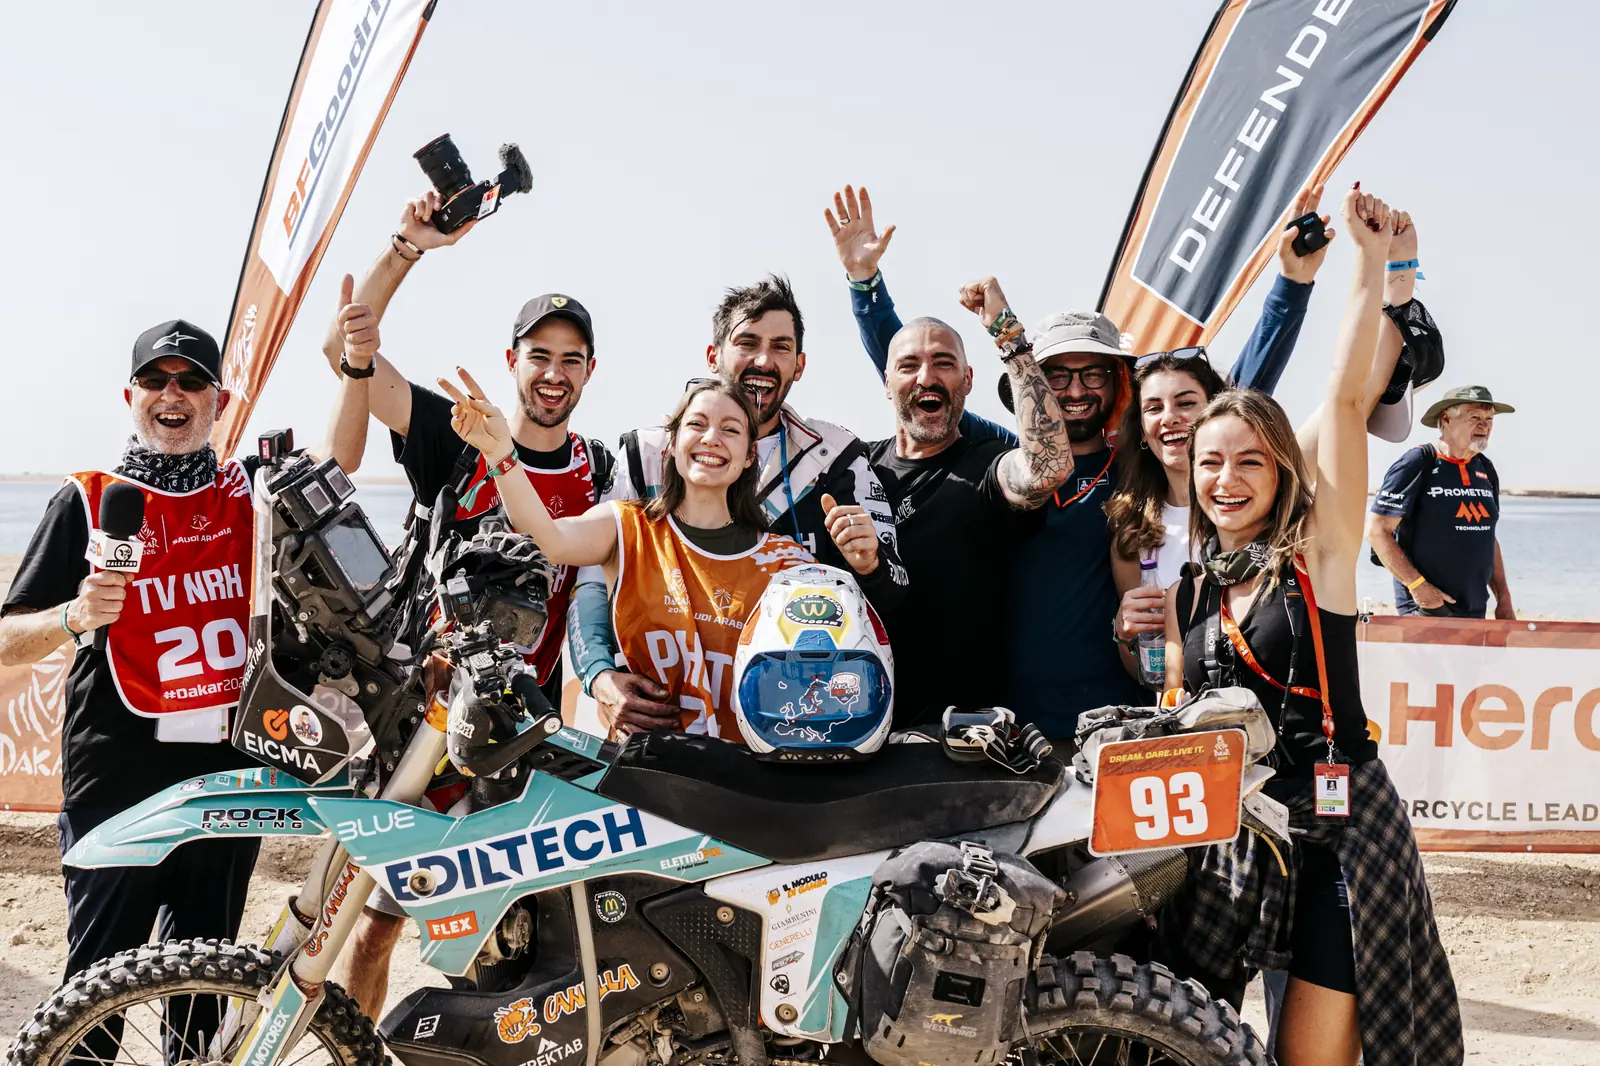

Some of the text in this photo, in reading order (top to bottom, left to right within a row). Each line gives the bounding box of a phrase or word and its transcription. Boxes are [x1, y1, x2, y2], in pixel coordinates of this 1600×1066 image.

[1169, 0, 1353, 273] DEFENDE
[172, 528, 232, 545] SAUDI ARABIA
[132, 564, 244, 615] TV NRH
[154, 617, 246, 682] 20
[243, 730, 323, 775] EICMA
[1109, 754, 1144, 764] DREAM.
[1145, 750, 1173, 759] DARE.
[1173, 747, 1195, 756] LIVE
[202, 808, 303, 822] ROCK
[1130, 771, 1209, 841] 93
[1528, 802, 1599, 822] LEAD
[337, 809, 416, 842] BLUE
[385, 807, 647, 900] EDILTECH
[782, 871, 828, 892] IL MODULO
[798, 878, 828, 894] GAMBA
[432, 917, 473, 936] FLEX
[771, 908, 817, 931] GIAMBENINI
[769, 928, 812, 951] GENERELLI
[544, 964, 641, 1023] CANLLA
[250, 1009, 290, 1066] MOTOREX
